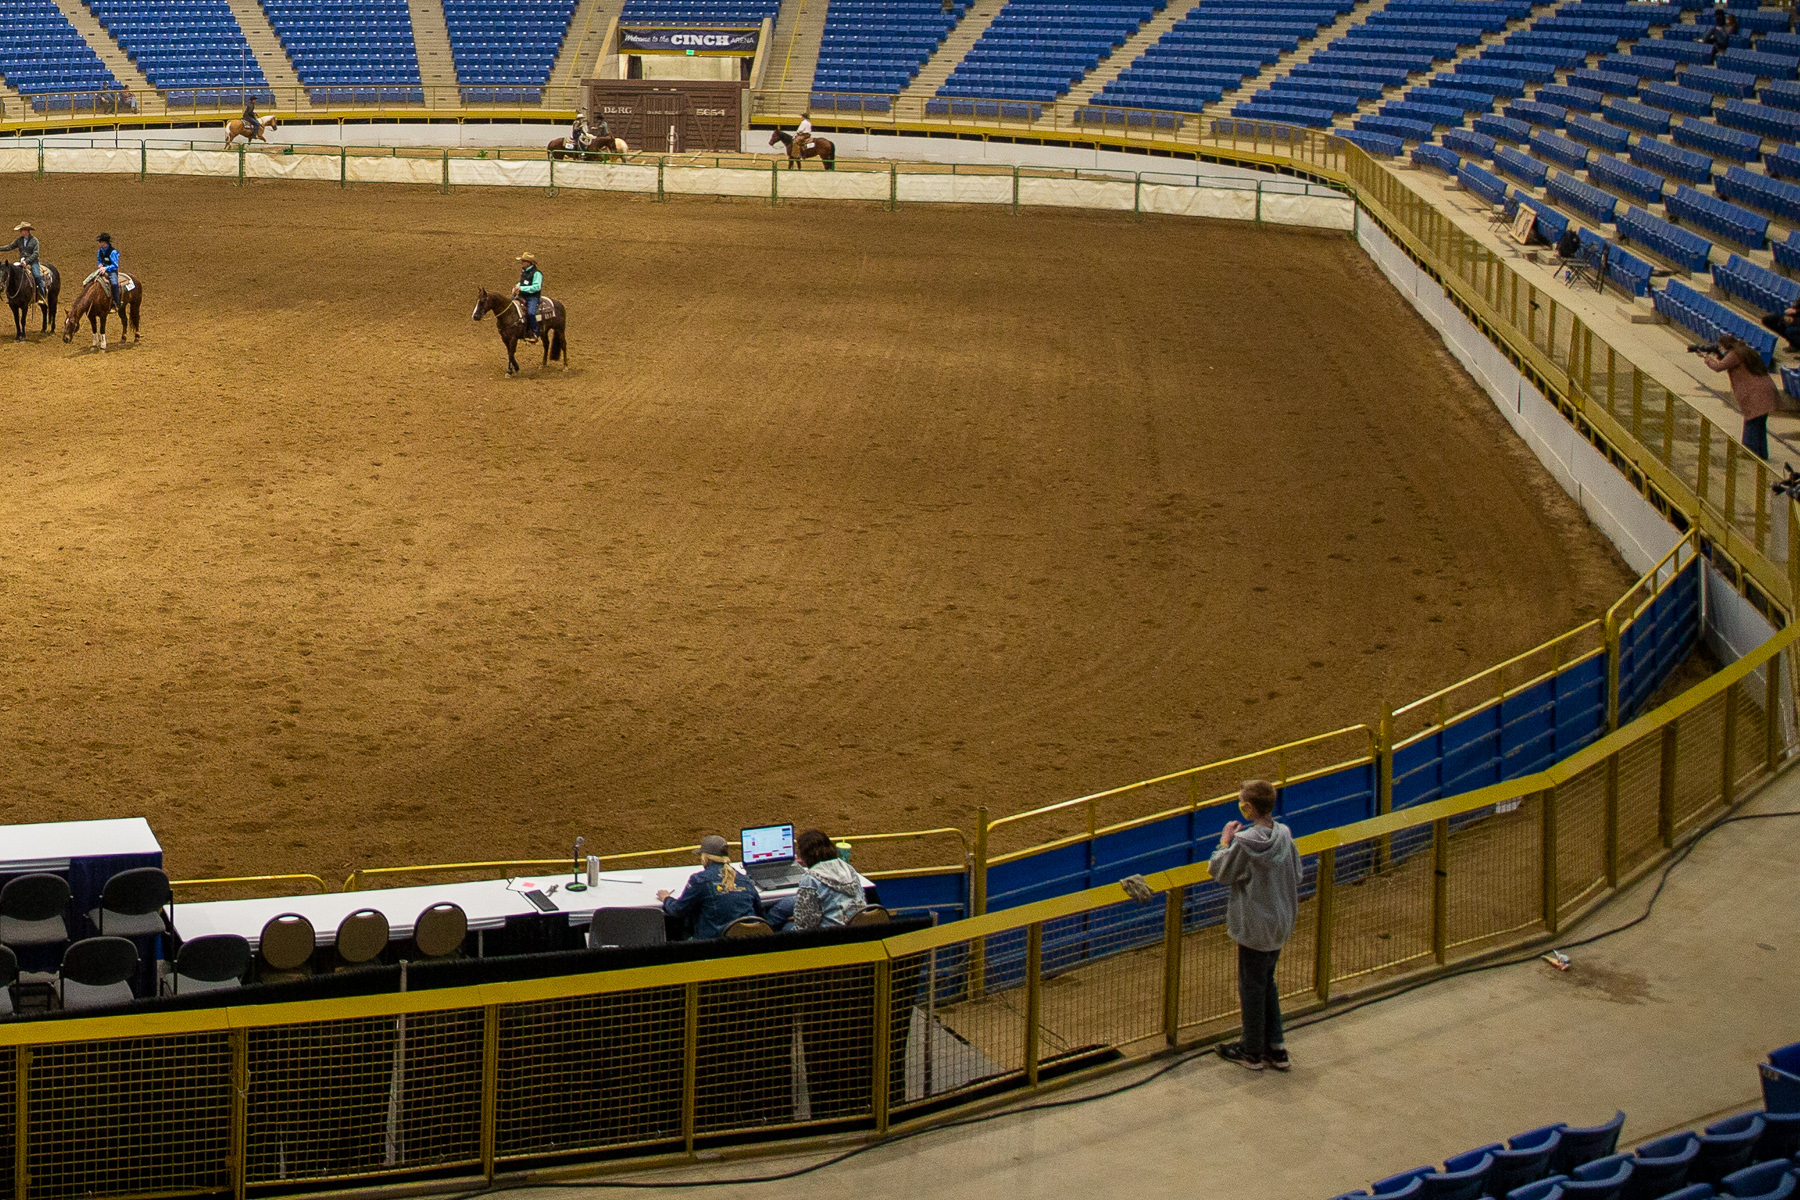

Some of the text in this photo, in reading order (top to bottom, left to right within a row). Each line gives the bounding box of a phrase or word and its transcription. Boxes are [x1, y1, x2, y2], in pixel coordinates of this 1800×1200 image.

[652, 35, 660, 43] to
[660, 34, 669, 43] the
[670, 34, 730, 46] CINCH
[730, 36, 754, 44] ARENA
